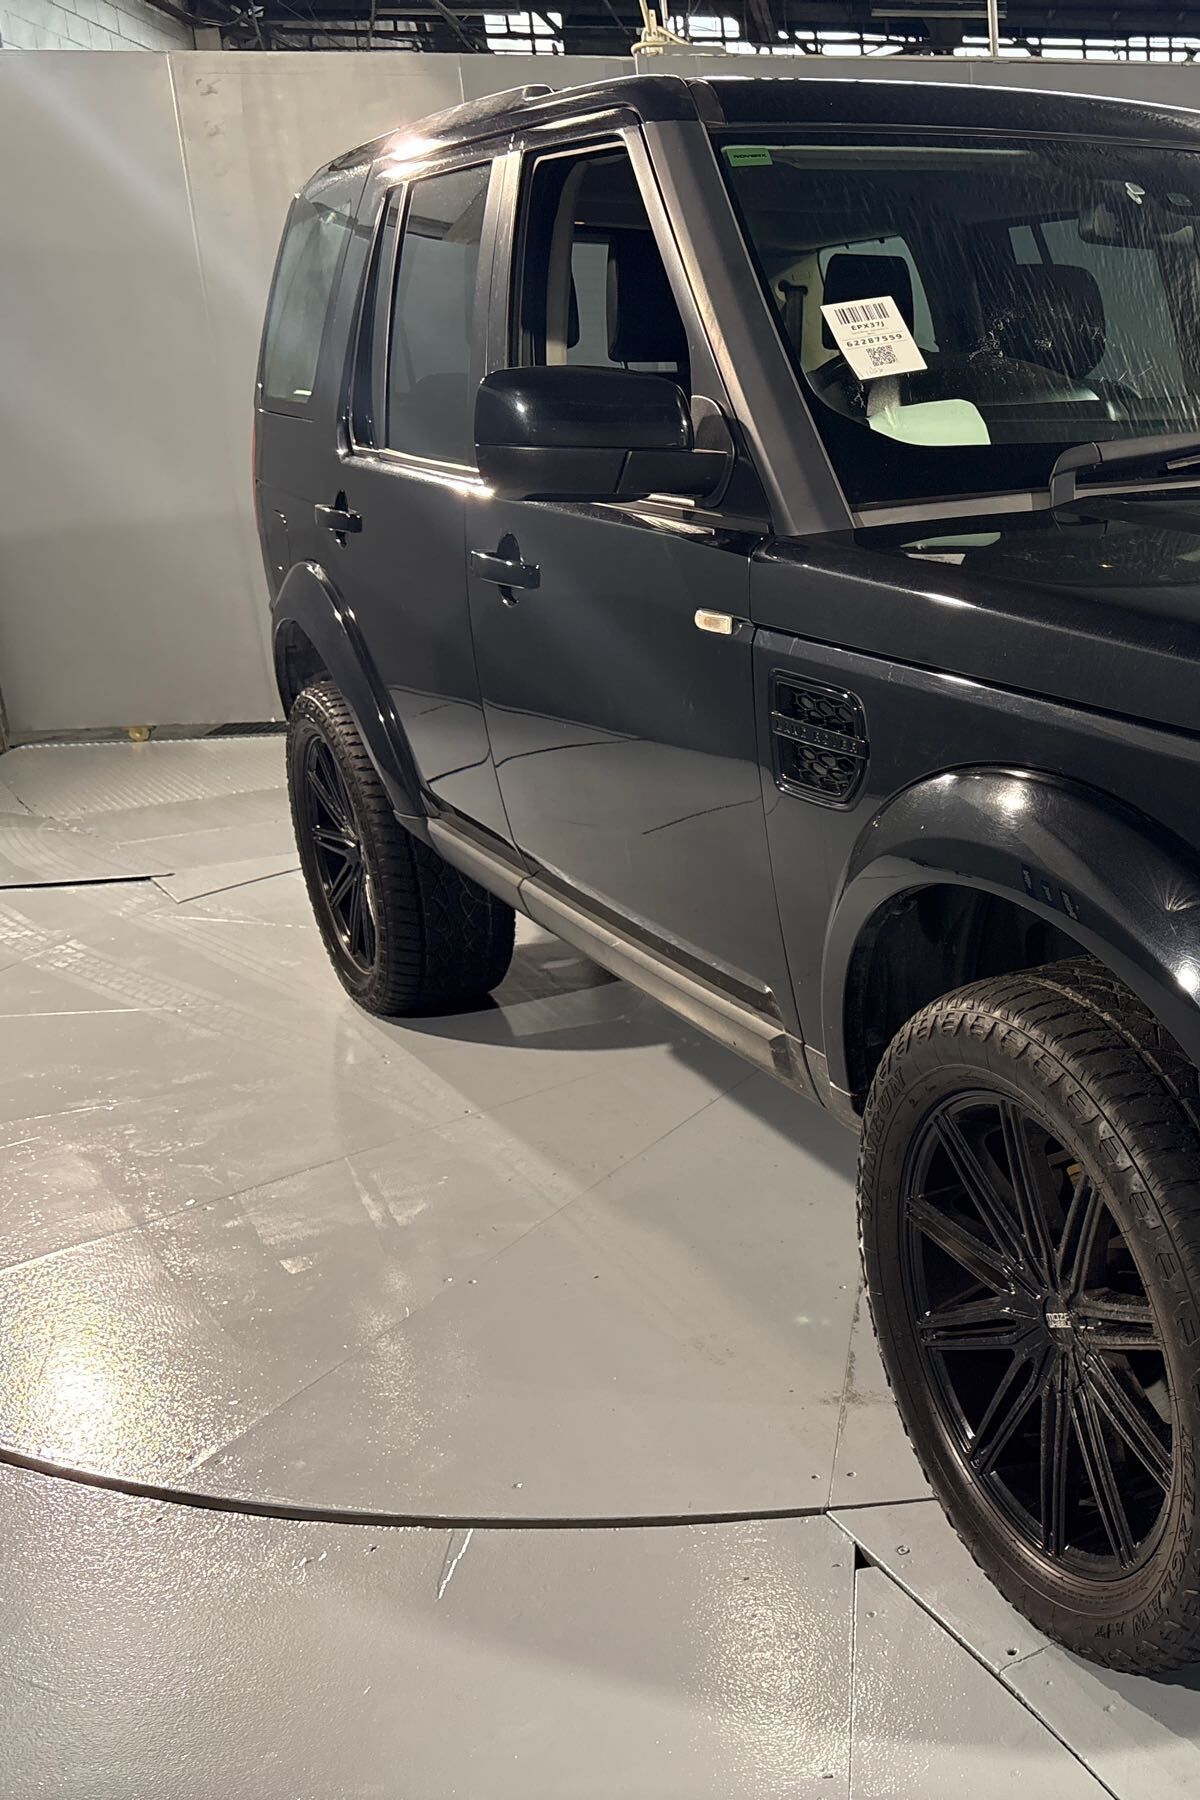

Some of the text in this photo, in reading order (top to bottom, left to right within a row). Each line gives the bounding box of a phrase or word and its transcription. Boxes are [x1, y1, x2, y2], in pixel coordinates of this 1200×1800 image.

[851, 321, 885, 330] EPX37J
[846, 333, 902, 347] 62287559
[861, 1067, 906, 1222] WINRUN
